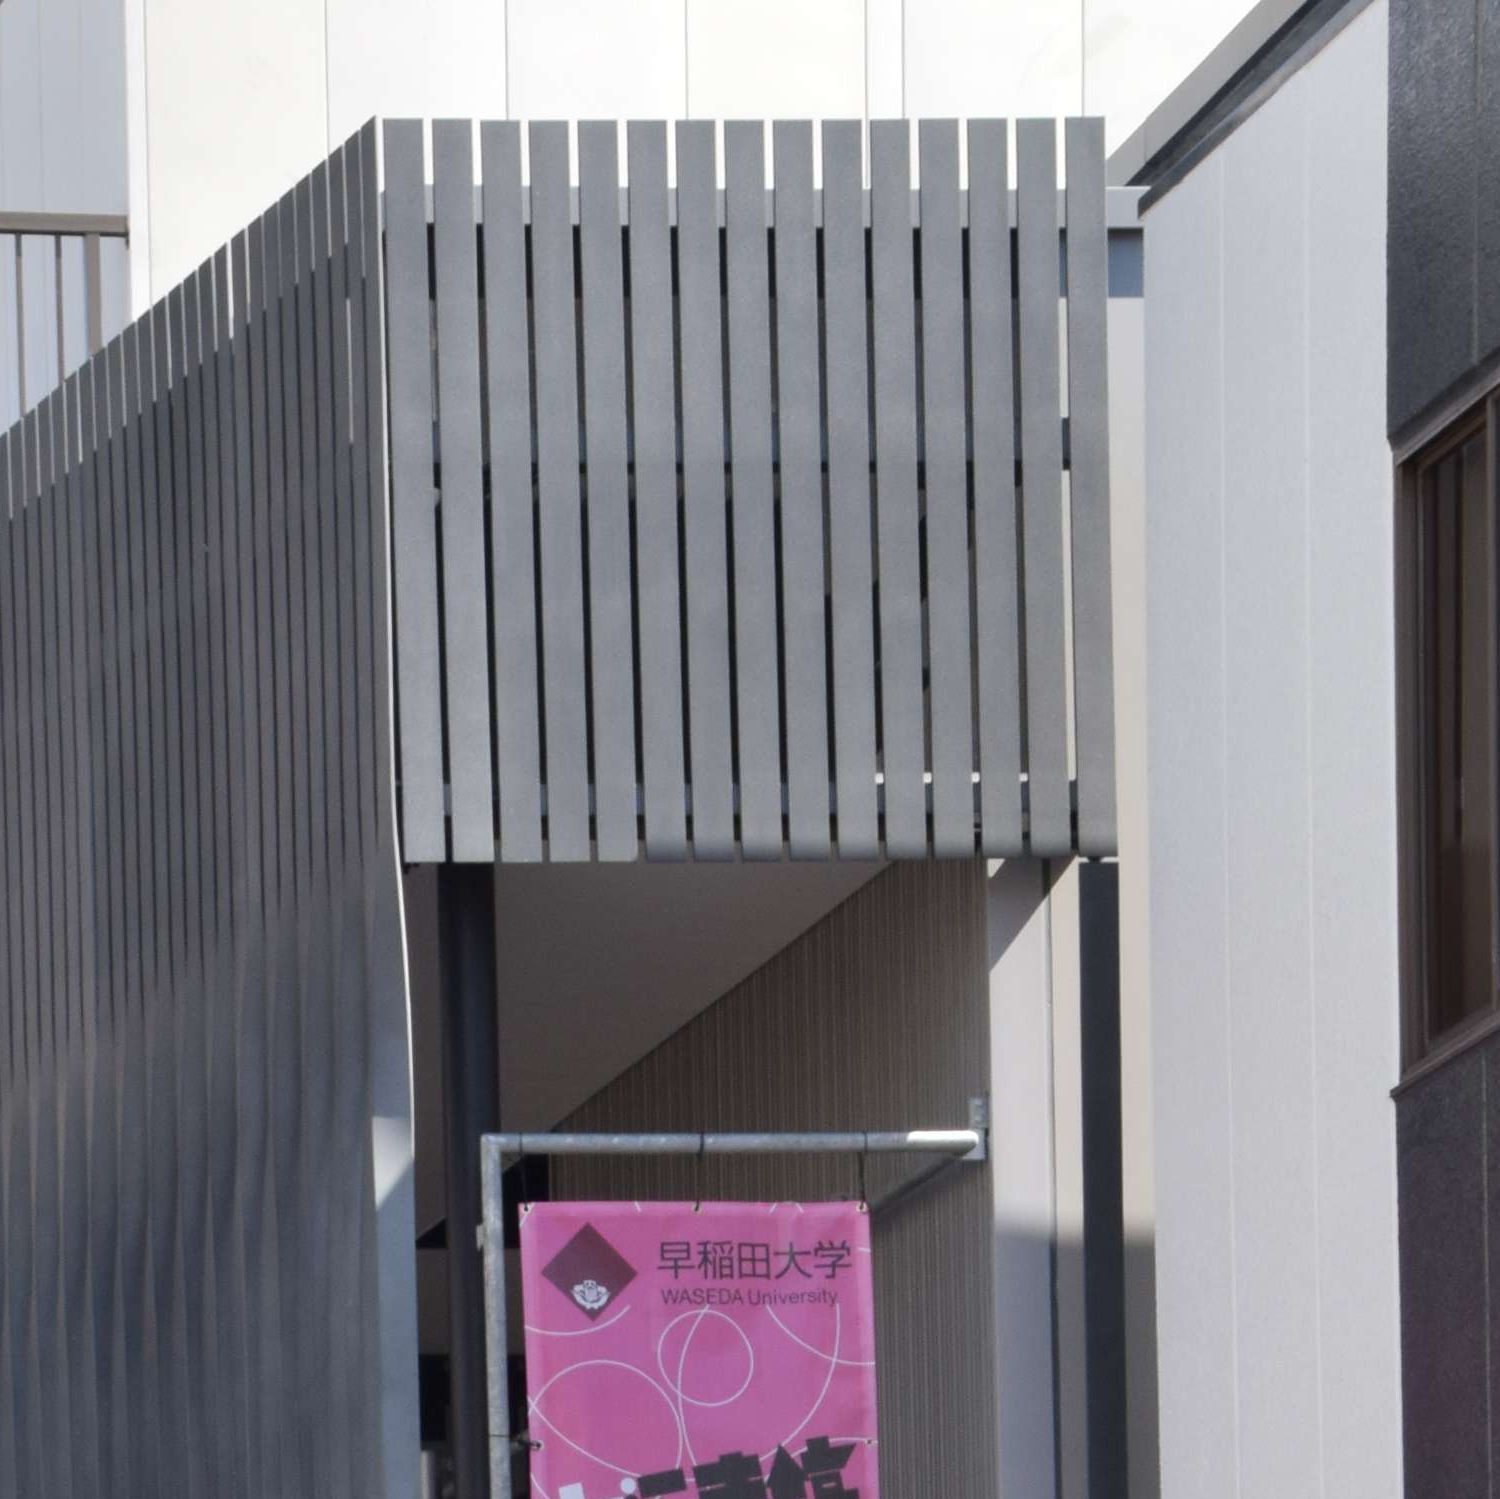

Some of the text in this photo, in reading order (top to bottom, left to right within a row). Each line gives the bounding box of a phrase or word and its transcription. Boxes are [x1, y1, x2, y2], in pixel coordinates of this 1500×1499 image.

[657, 1240, 852, 1280] 早稲田大学
[660, 1286, 838, 1307] WASEDA University
